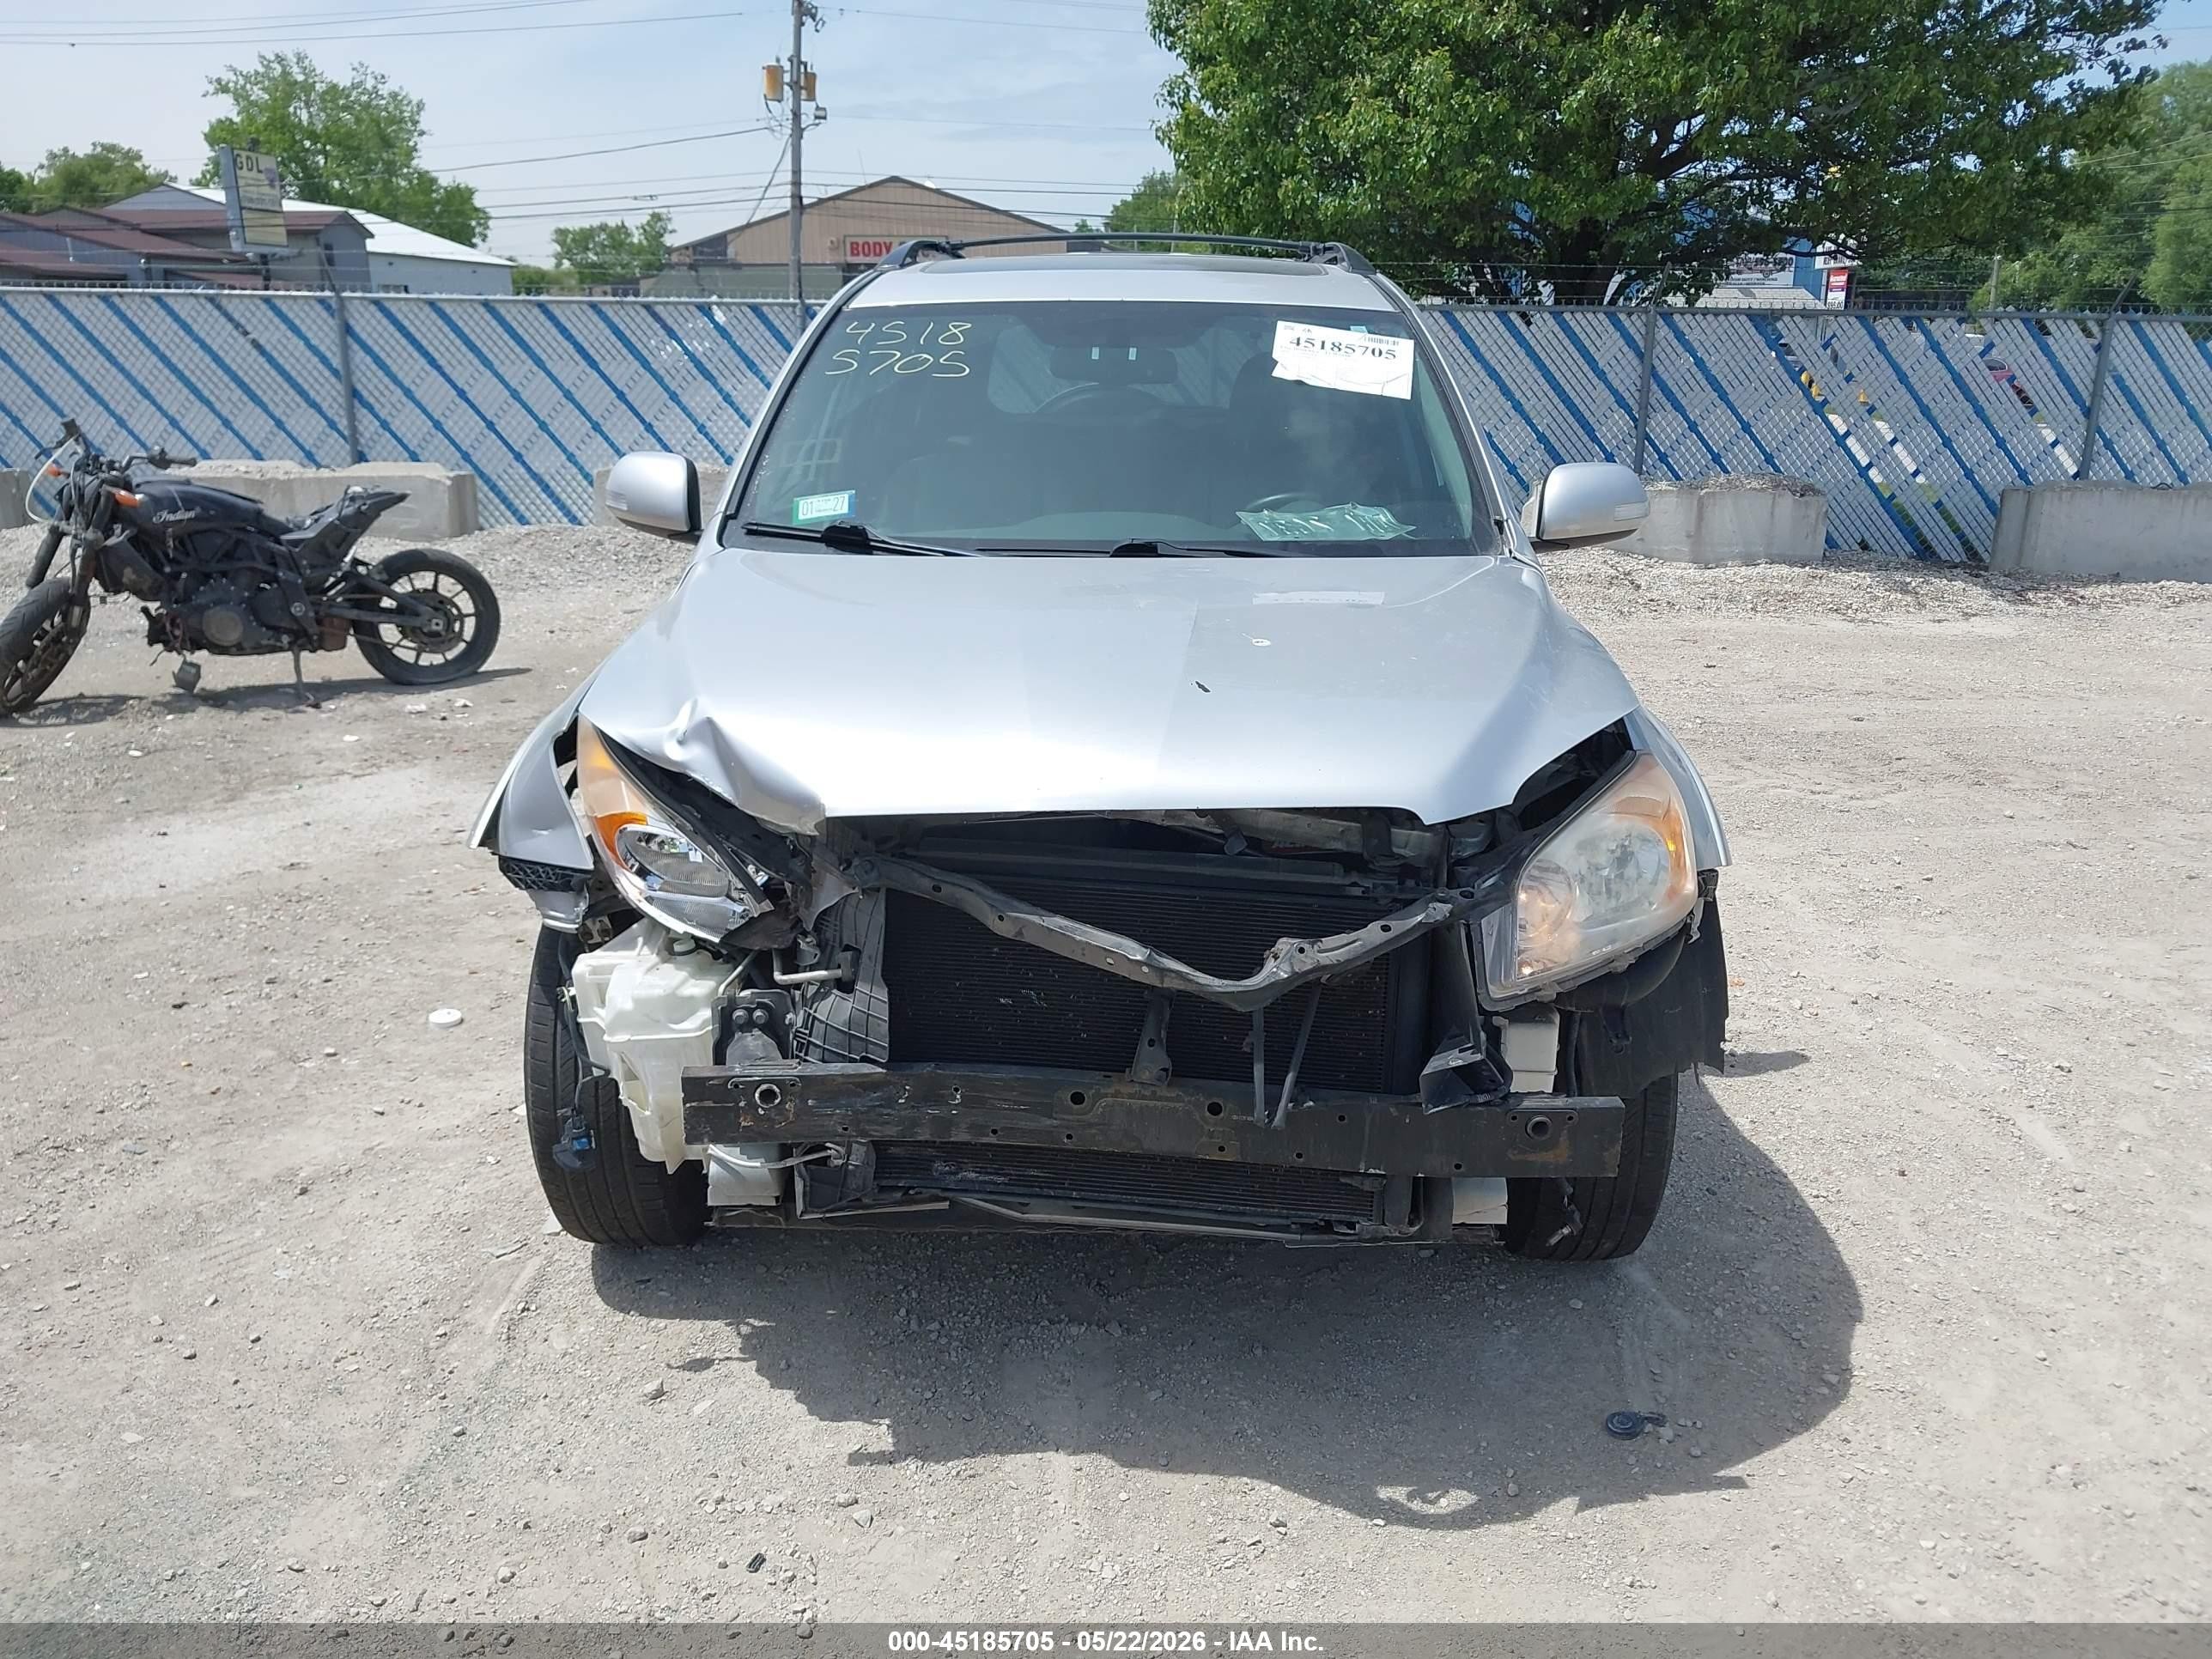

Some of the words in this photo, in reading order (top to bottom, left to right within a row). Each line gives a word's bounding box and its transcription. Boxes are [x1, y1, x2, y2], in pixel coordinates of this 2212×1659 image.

[234, 154, 264, 173] GDL
[849, 241, 893, 258] BODY
[846, 321, 972, 344] 4518
[1290, 336, 1397, 360] 45185705
[824, 349, 970, 378] 5705
[152, 508, 197, 524] Indian
[801, 501, 814, 516] 01
[832, 495, 846, 512] 27
